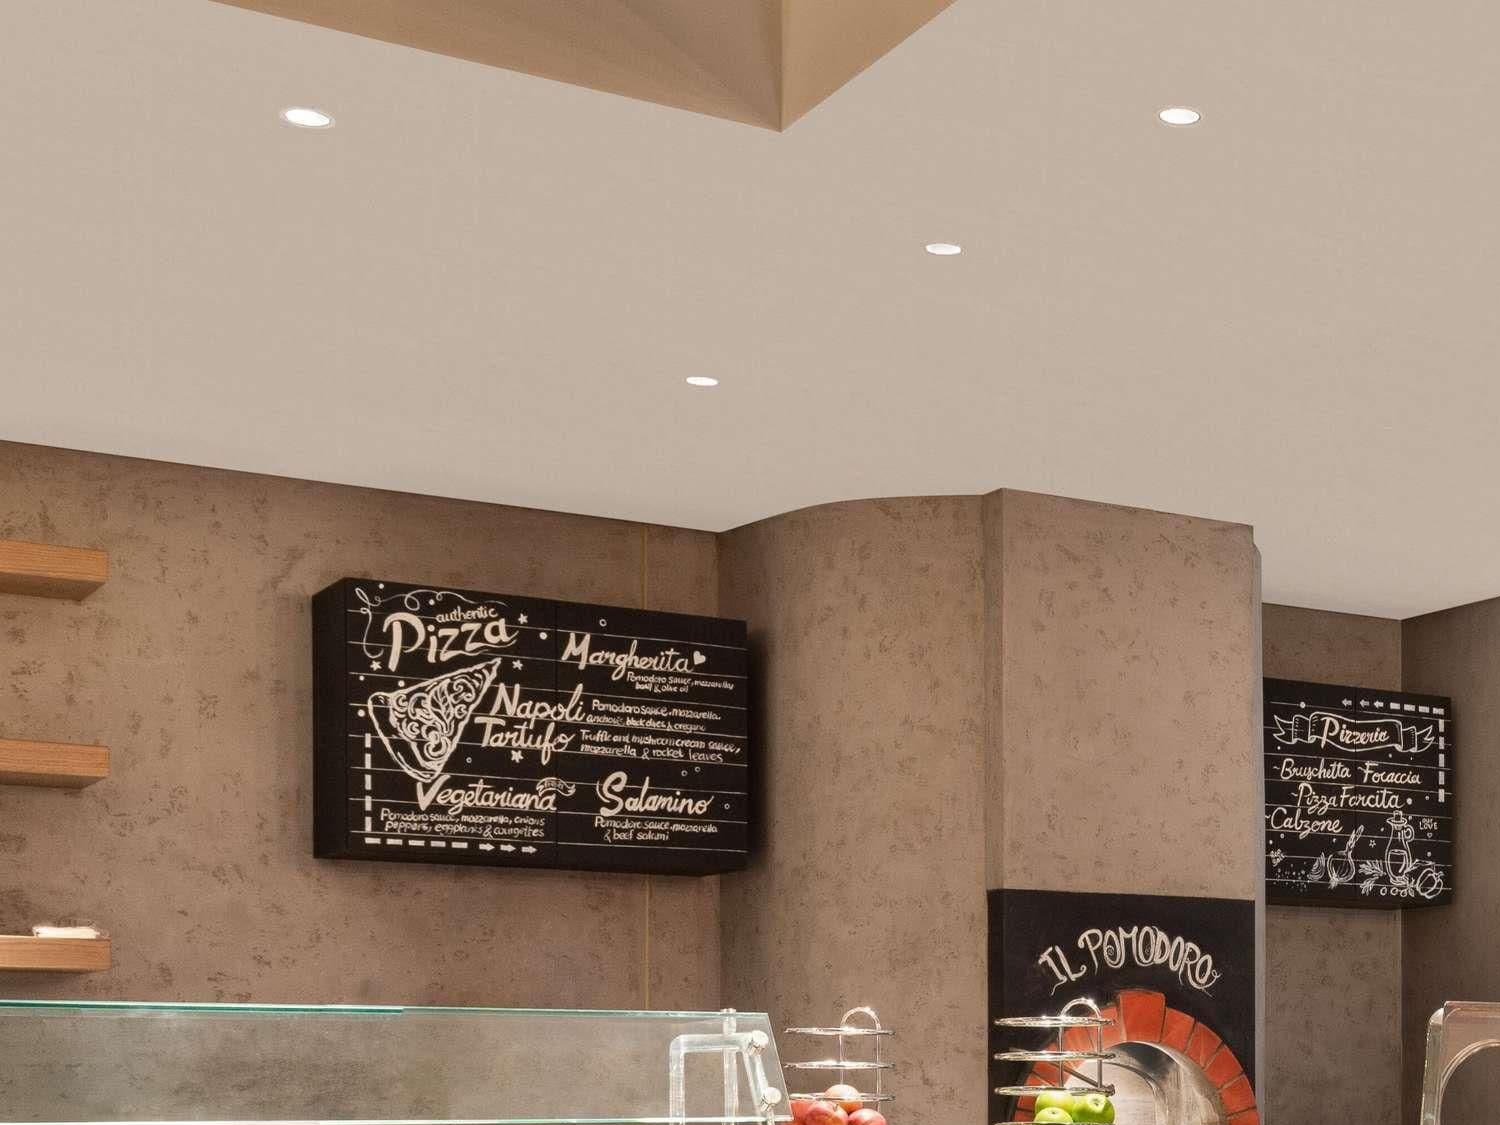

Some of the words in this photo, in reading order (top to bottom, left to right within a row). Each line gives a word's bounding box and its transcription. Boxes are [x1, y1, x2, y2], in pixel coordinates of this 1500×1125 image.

[435, 605, 499, 623] authentic
[382, 612, 519, 672] Pizza
[561, 632, 694, 681] Margherita
[626, 671, 667, 685] Pomodoro
[488, 683, 586, 730] Napoli
[592, 699, 640, 714] Pomodoro
[474, 716, 576, 766] Tartufo
[580, 729, 612, 742] Truffle
[675, 737, 706, 750] cream
[1320, 717, 1390, 749] Pizzeria
[580, 743, 637, 757] mozzarella
[641, 747, 650, 760] &
[1280, 758, 1352, 780] Bruschetta
[1363, 761, 1422, 785] Focaccia
[416, 774, 558, 815] Vegetariana
[599, 771, 715, 817] Salamino
[1297, 782, 1337, 814] Pizza
[380, 807, 430, 822] Pomodoro
[1270, 807, 1344, 840] Calzone
[482, 826, 494, 840] &
[613, 828, 635, 841] beef
[1038, 945, 1087, 996] IL
[1078, 925, 1221, 995] POMODORO
